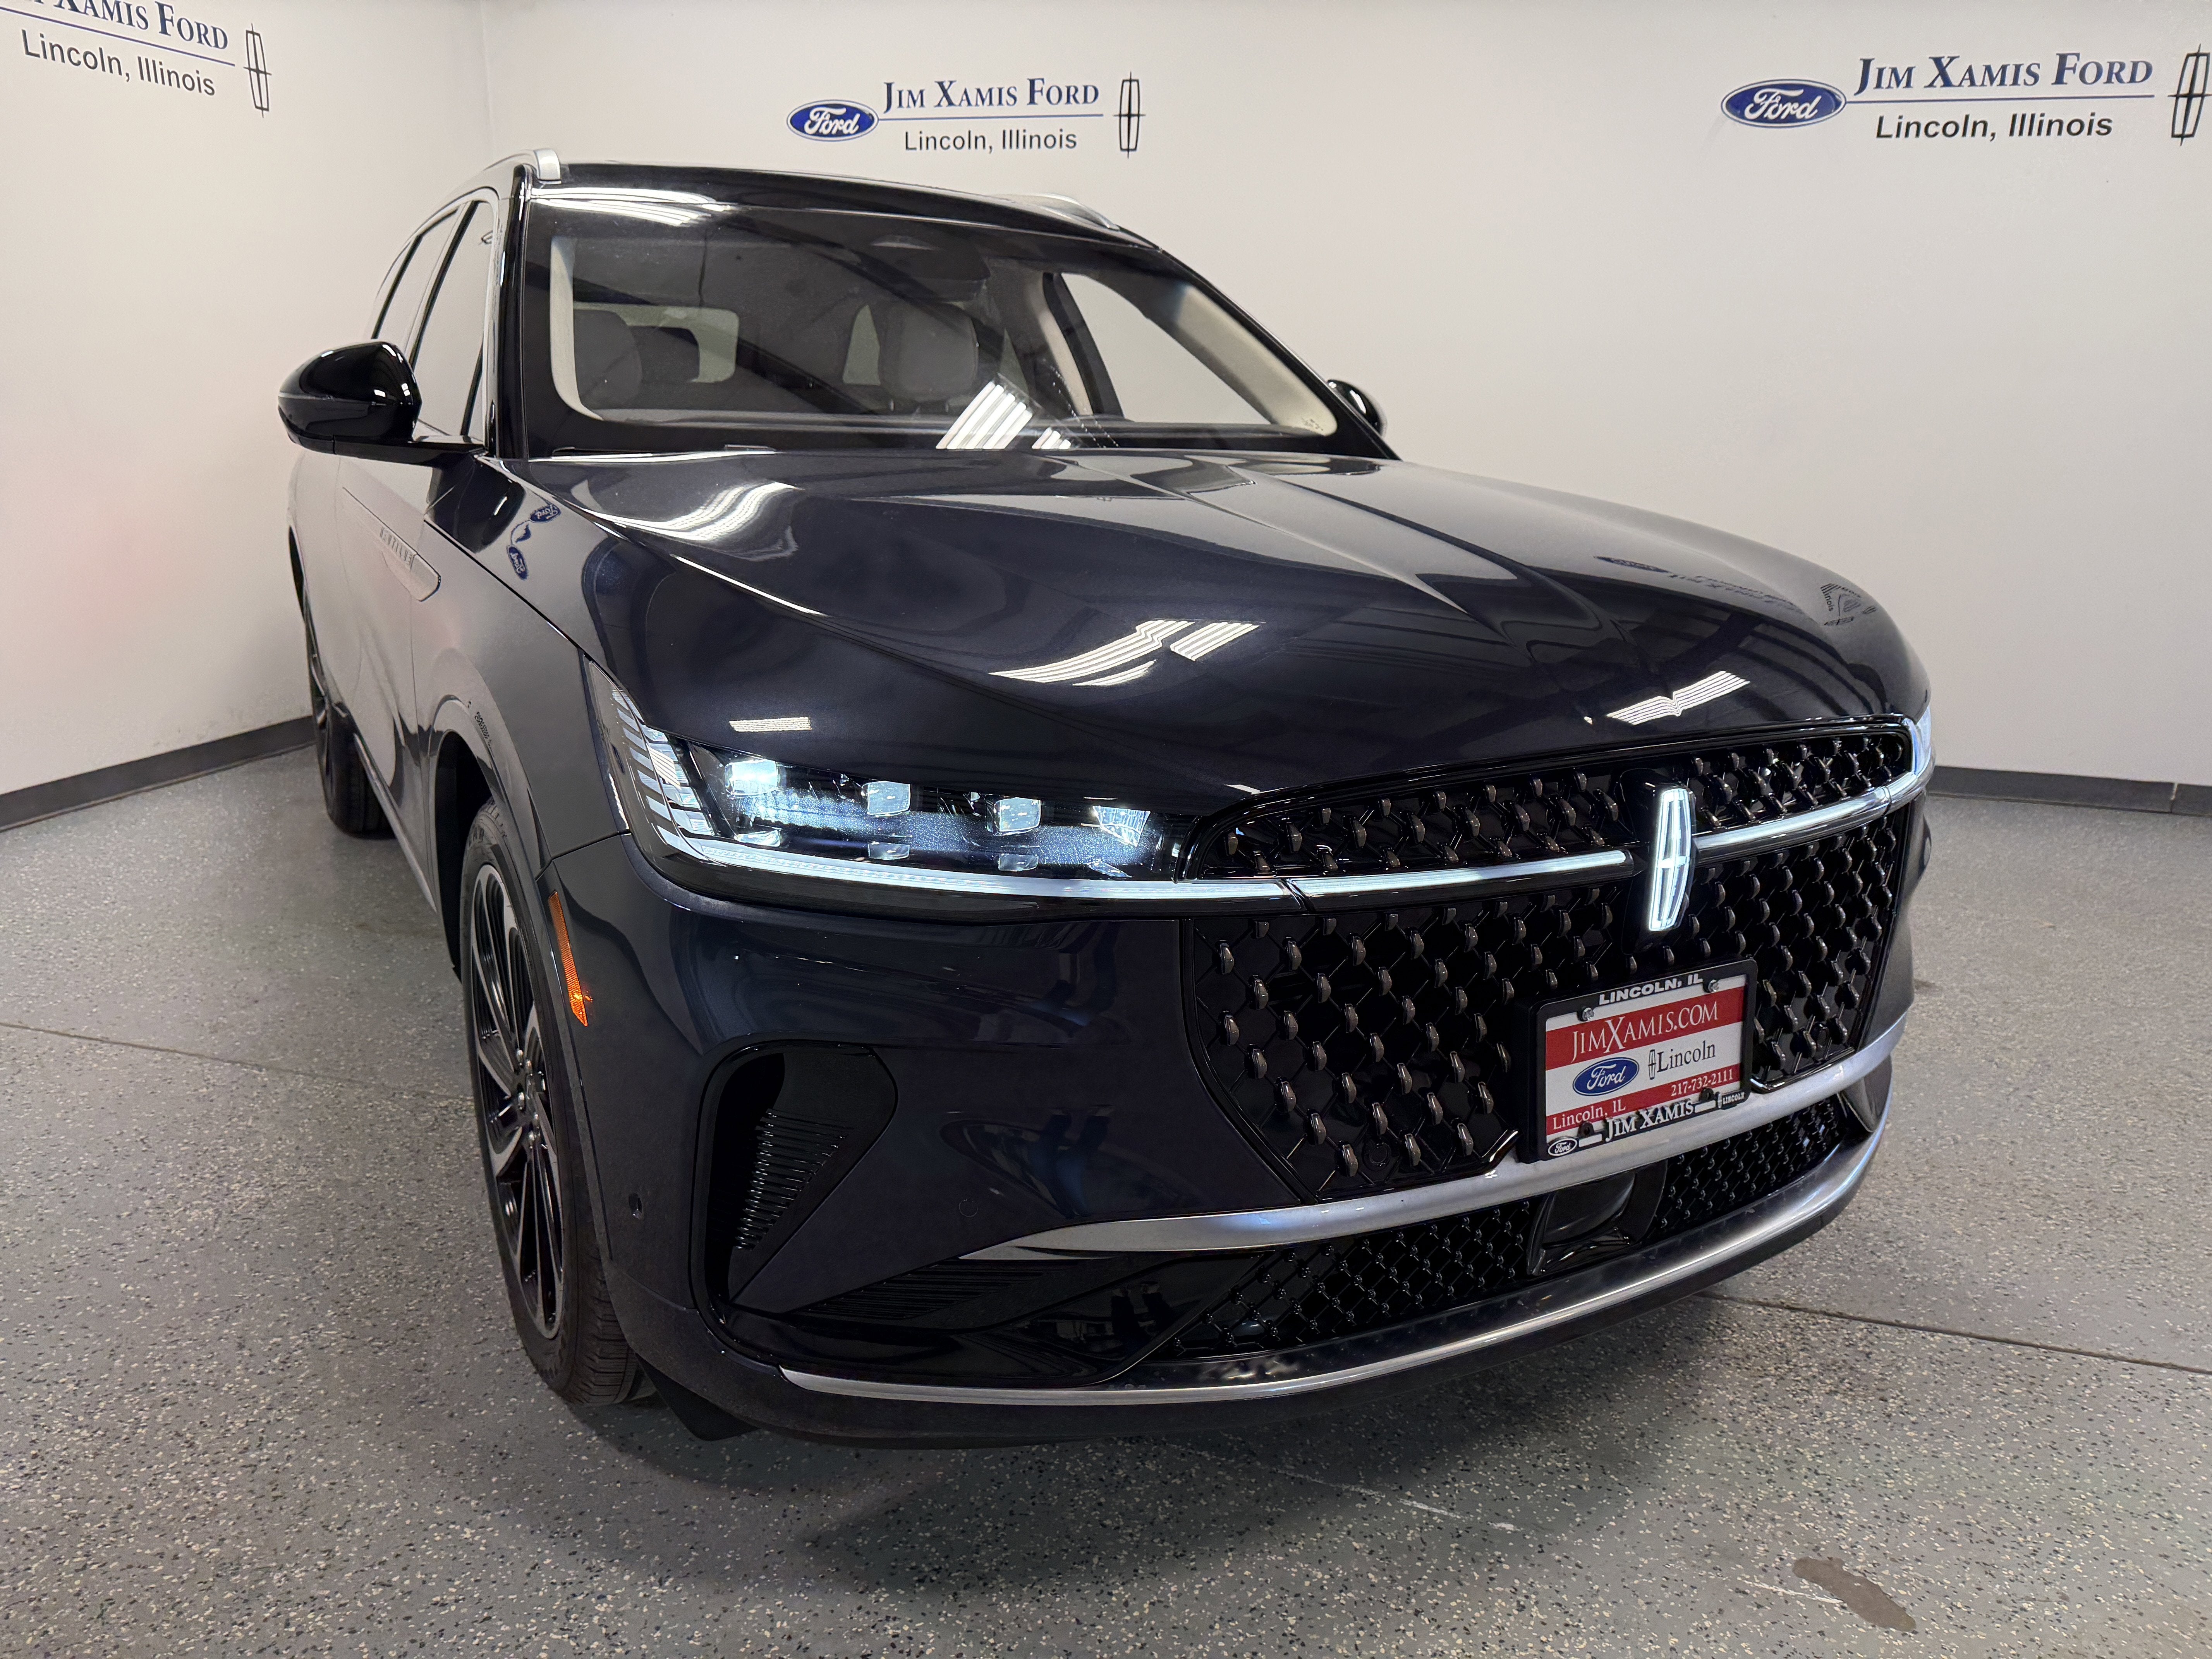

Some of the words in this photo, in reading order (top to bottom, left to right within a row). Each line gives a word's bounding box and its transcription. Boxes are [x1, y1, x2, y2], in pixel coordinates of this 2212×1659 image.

[54, 0, 149, 30] AMIS
[156, 2, 228, 50] FORD
[21, 29, 130, 82] Lincoln,
[137, 56, 215, 96] Illinois
[1854, 58, 1915, 96] JIM
[1925, 55, 2040, 88] XAMIS
[2051, 53, 2153, 85] FORD
[884, 82, 925, 113] JIM
[934, 80, 1017, 108] XAMIS
[1027, 78, 1099, 105] FORD
[1744, 88, 1822, 120] Ford
[804, 107, 860, 134] Ford
[1876, 114, 1996, 142] Lincoln,
[2009, 112, 2113, 137] Illinois
[905, 130, 993, 154] Lincoln,
[1002, 129, 1077, 149] Illinois
[1599, 977, 1682, 1005] LINCOLN,
[1687, 973, 1703, 985] IL
[1571, 1001, 1718, 1063] JIMXAMIS.COM
[1657, 1041, 1716, 1072] Lincoln
[1587, 1064, 1626, 1090] Ford
[1671, 1069, 1733, 1096] 217-732-2111
[1723, 1091, 1745, 1104] LINCOLN
[1553, 1106, 1607, 1130] Lincoln,
[1613, 1099, 1626, 1113] IL
[1605, 1117, 1637, 1142] JIM
[1640, 1100, 1694, 1129] XAMIS
[1554, 1142, 1571, 1153] Ford
